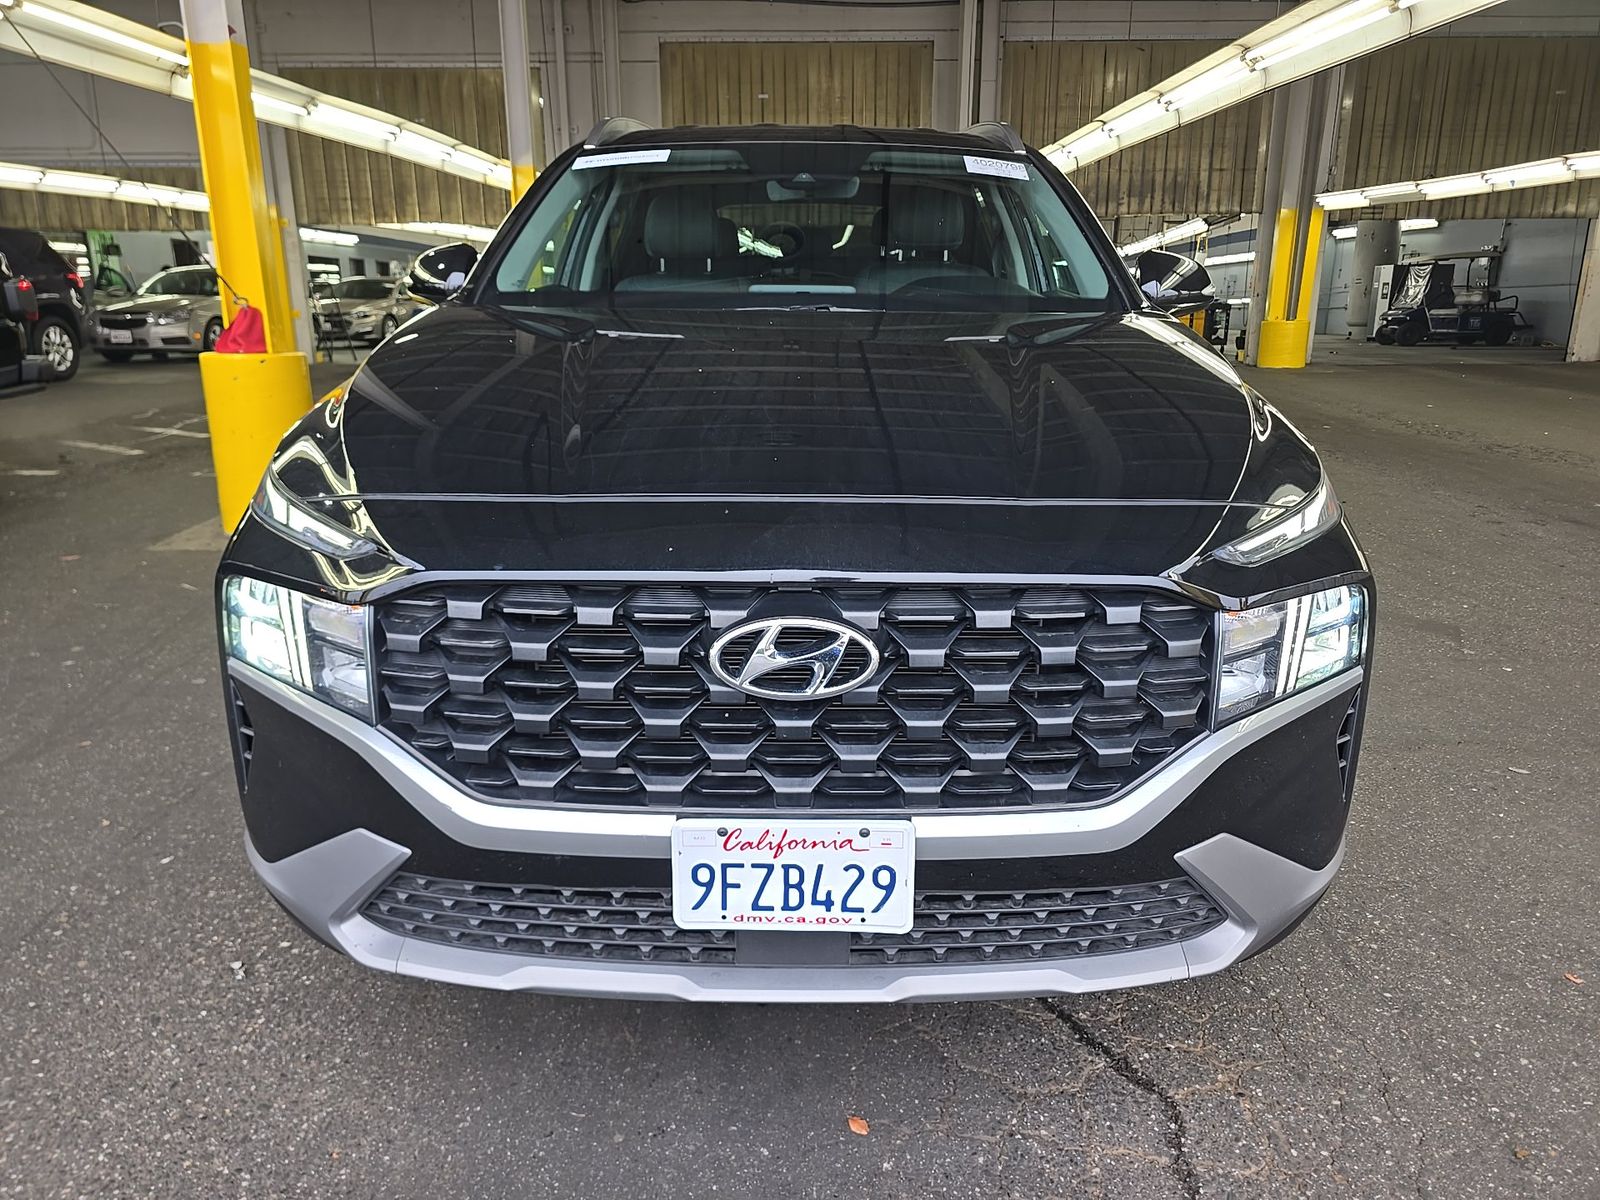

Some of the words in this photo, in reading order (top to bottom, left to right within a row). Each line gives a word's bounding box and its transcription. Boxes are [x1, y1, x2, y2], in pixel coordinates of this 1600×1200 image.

[722, 828, 870, 859] California
[691, 862, 897, 914] 9FZB429
[733, 914, 853, 925] dmv.ca.gov
